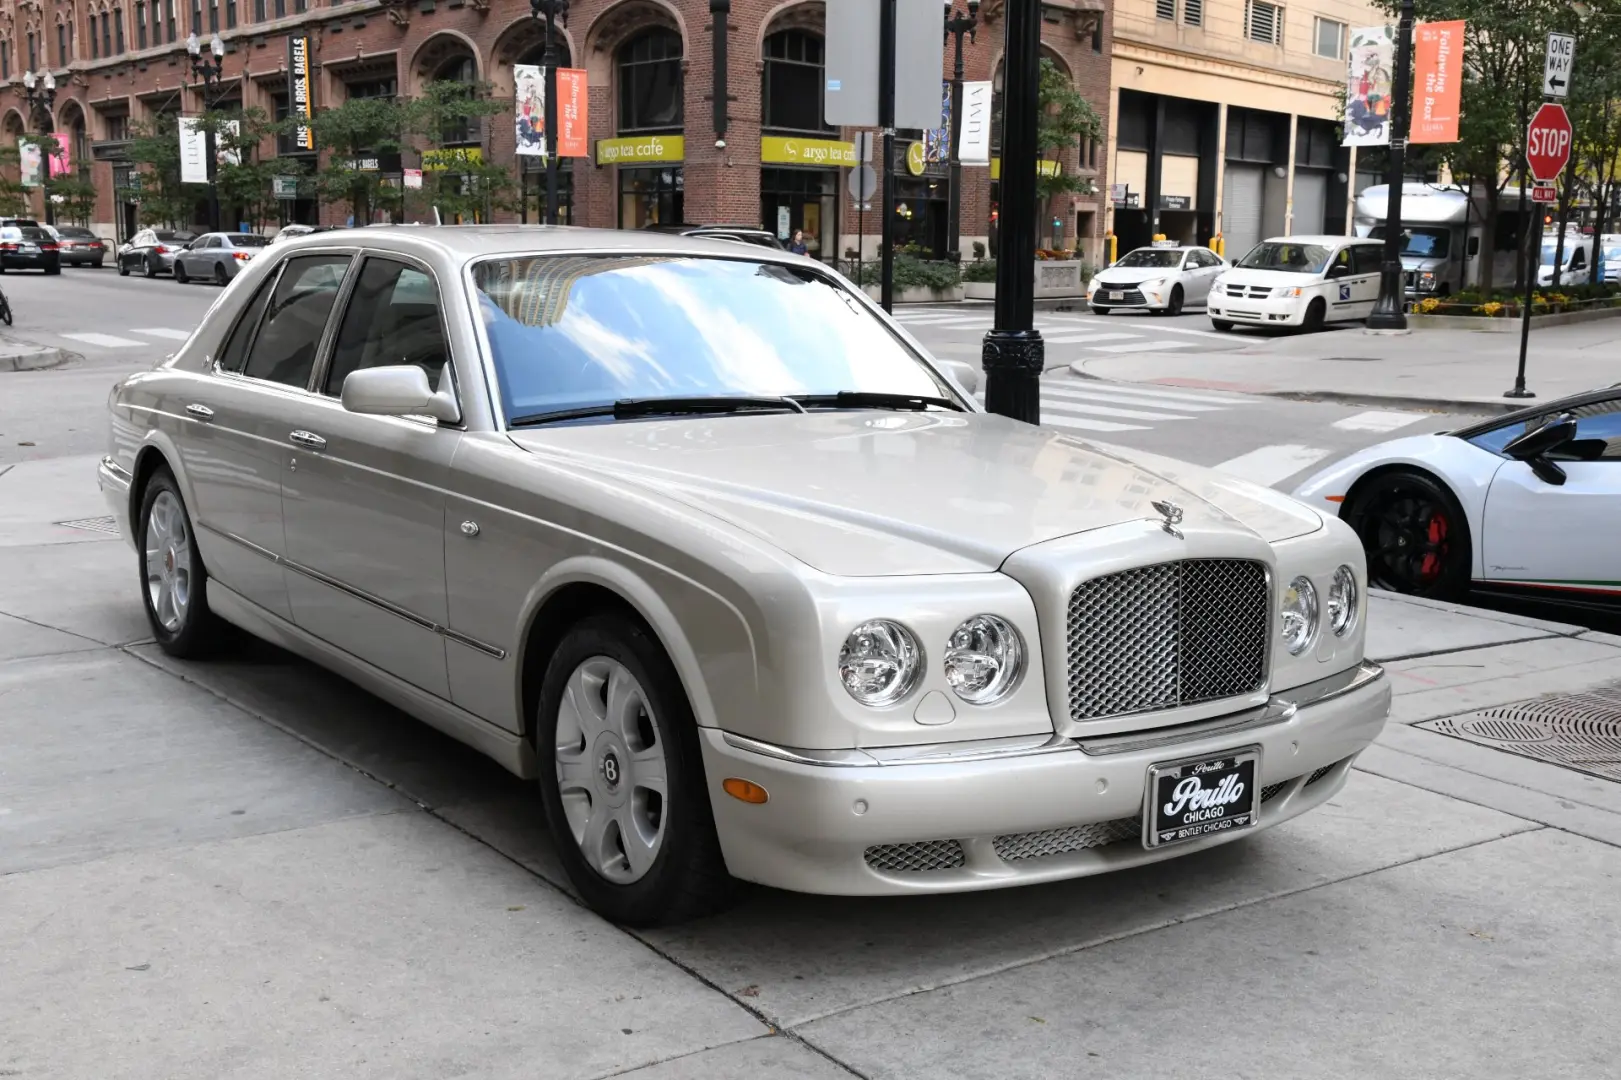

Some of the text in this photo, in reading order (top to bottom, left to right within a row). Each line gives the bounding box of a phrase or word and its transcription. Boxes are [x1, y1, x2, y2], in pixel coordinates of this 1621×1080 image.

[293, 38, 305, 75] BAGELS
[1551, 39, 1571, 55] ONE
[1434, 30, 1450, 93] Following
[1549, 56, 1570, 72] WAY
[571, 74, 579, 120] Following
[1424, 73, 1436, 120] the Box
[297, 104, 308, 147] EINSN
[968, 87, 983, 145] LUMA
[621, 145, 633, 156] tea
[637, 137, 663, 155] café
[803, 147, 827, 162] argo
[830, 147, 841, 160] tea
[1530, 128, 1568, 157] STOP
[1534, 189, 1554, 199] ALL WAY
[1183, 806, 1224, 824] CHICAGO
[1178, 820, 1232, 838] BENTLEY CHICAGO
